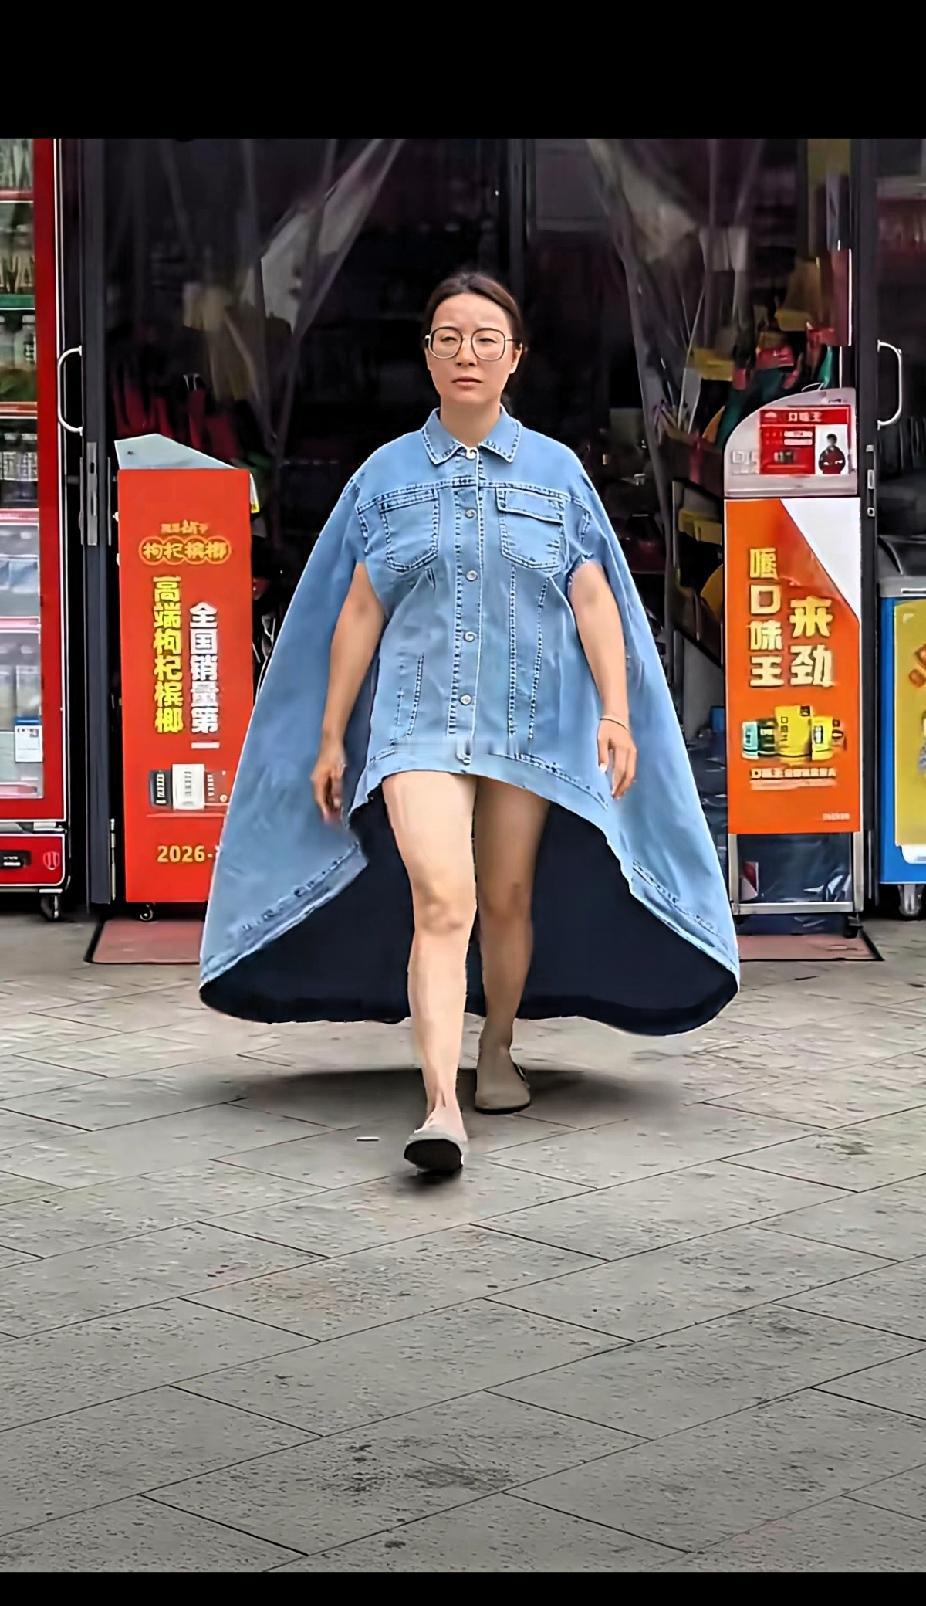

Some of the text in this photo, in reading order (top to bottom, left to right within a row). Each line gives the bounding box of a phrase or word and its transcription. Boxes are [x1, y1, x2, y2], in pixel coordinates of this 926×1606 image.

[153, 575, 184, 733] 高端枸杞槟榔
[189, 602, 220, 749] 全国销量第一
[788, 596, 835, 688] 来劲
[157, 845, 220, 863] 2026-
